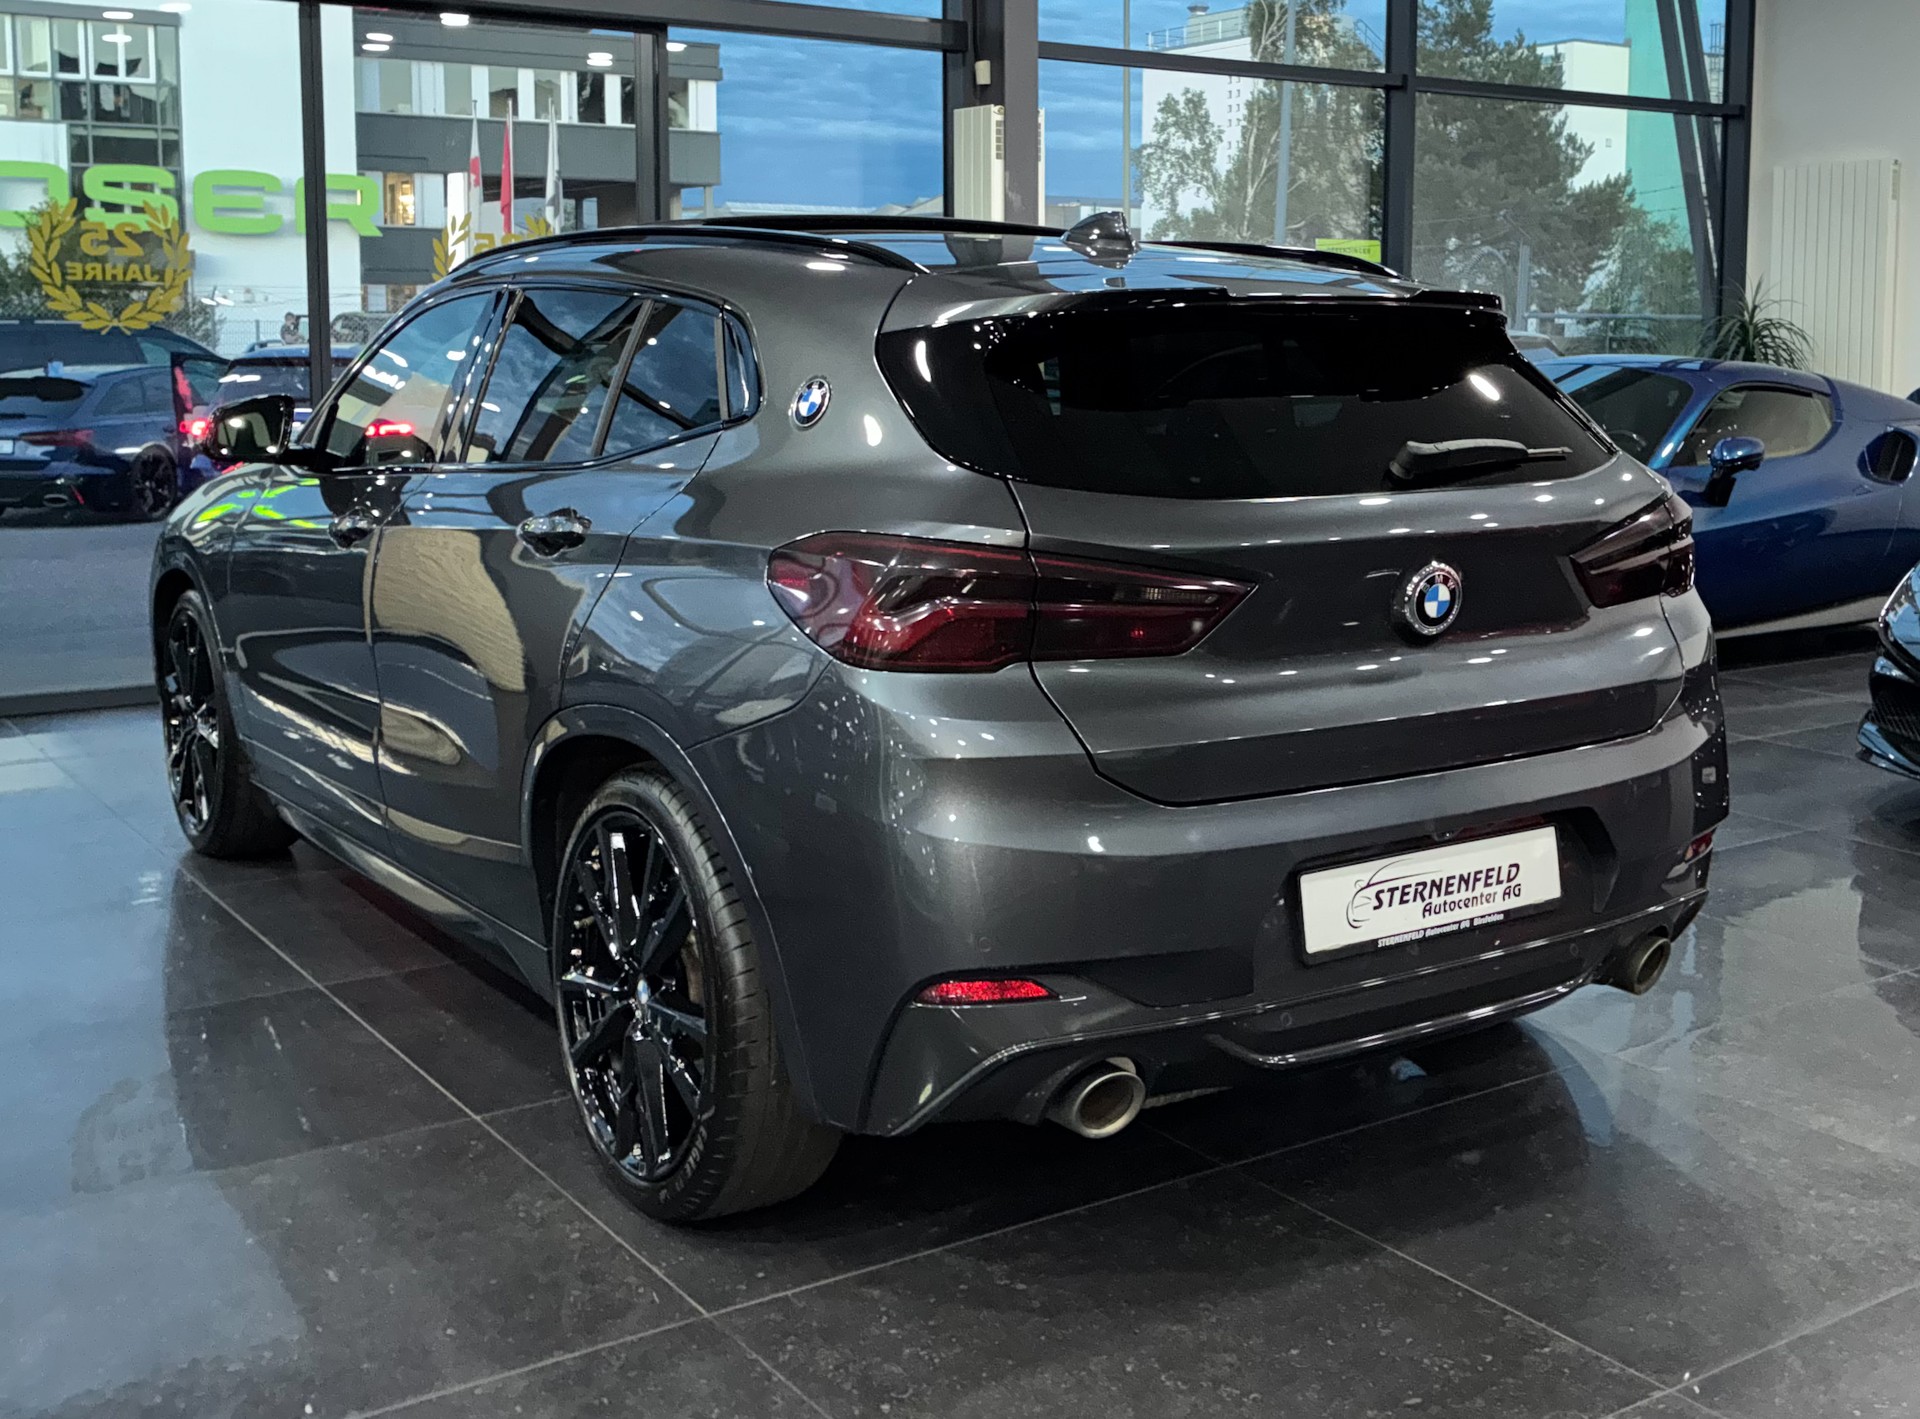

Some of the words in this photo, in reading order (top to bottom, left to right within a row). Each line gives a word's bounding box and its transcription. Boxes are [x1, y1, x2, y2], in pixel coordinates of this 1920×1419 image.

[1373, 863, 1520, 910] STERNENFELD
[1422, 890, 1498, 918] Autocenter
[1503, 883, 1521, 902] AG
